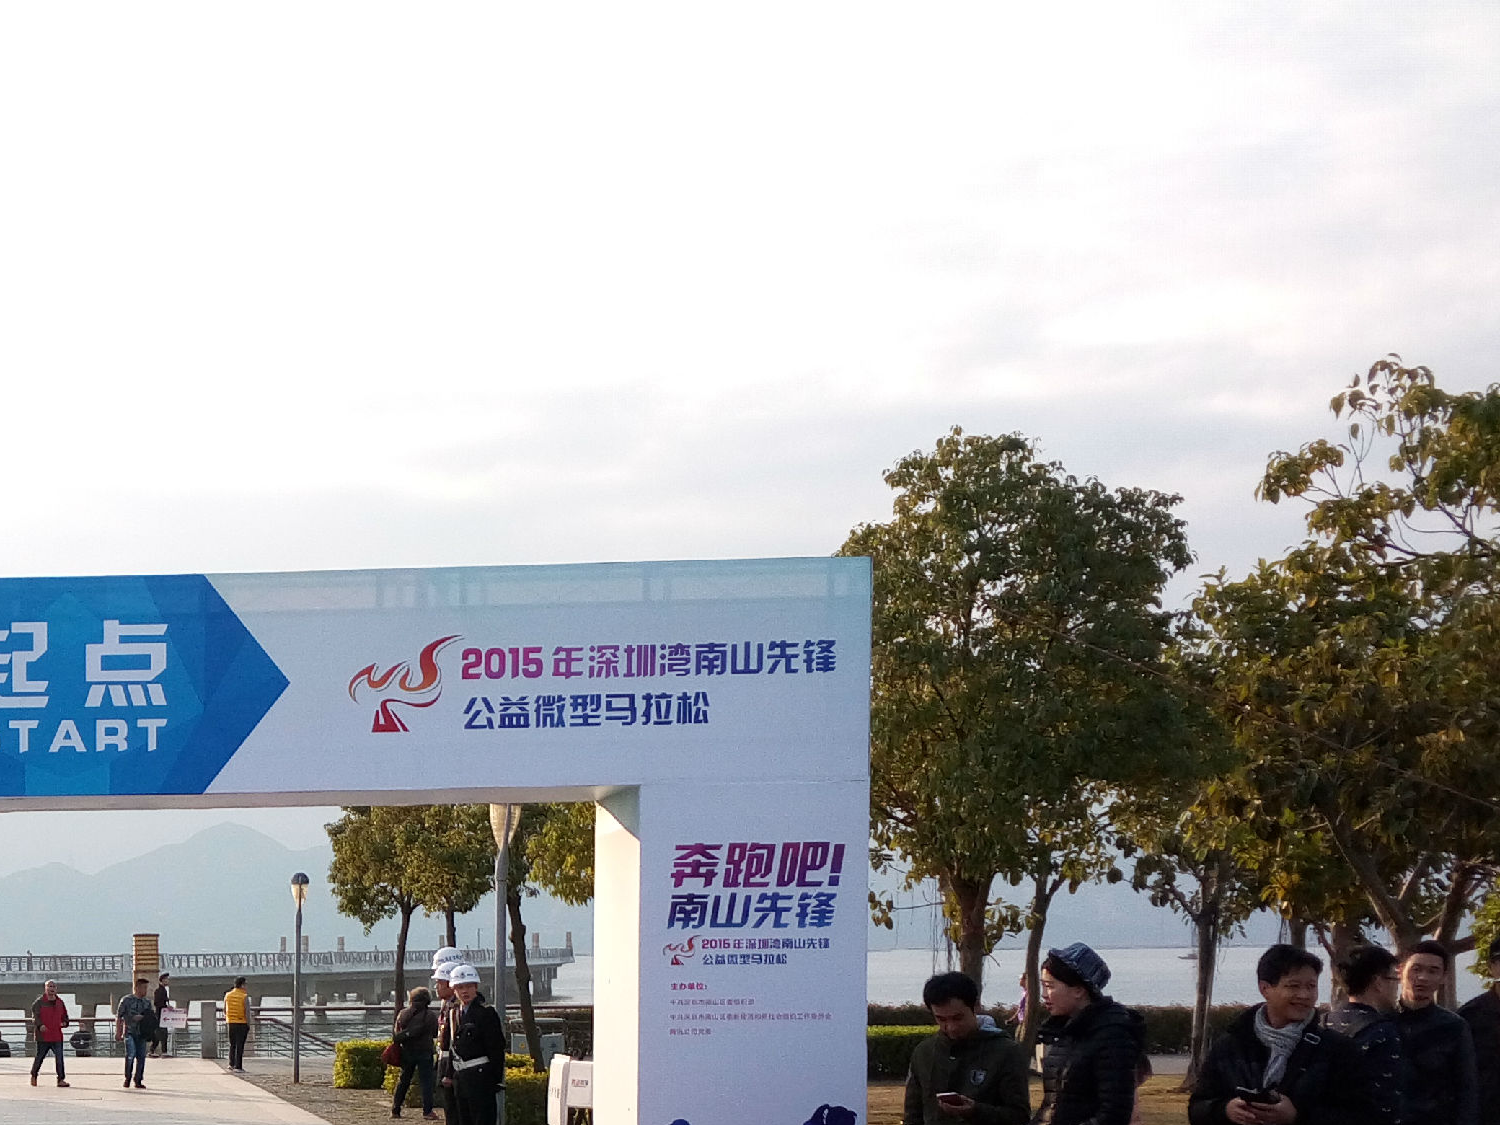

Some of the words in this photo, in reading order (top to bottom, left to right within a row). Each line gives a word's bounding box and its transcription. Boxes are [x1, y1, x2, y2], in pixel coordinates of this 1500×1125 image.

[463, 691, 710, 730] 公益微型马拉松
[670, 841, 846, 888] 奔跑吧!
[667, 892, 837, 929] 南山先锋
